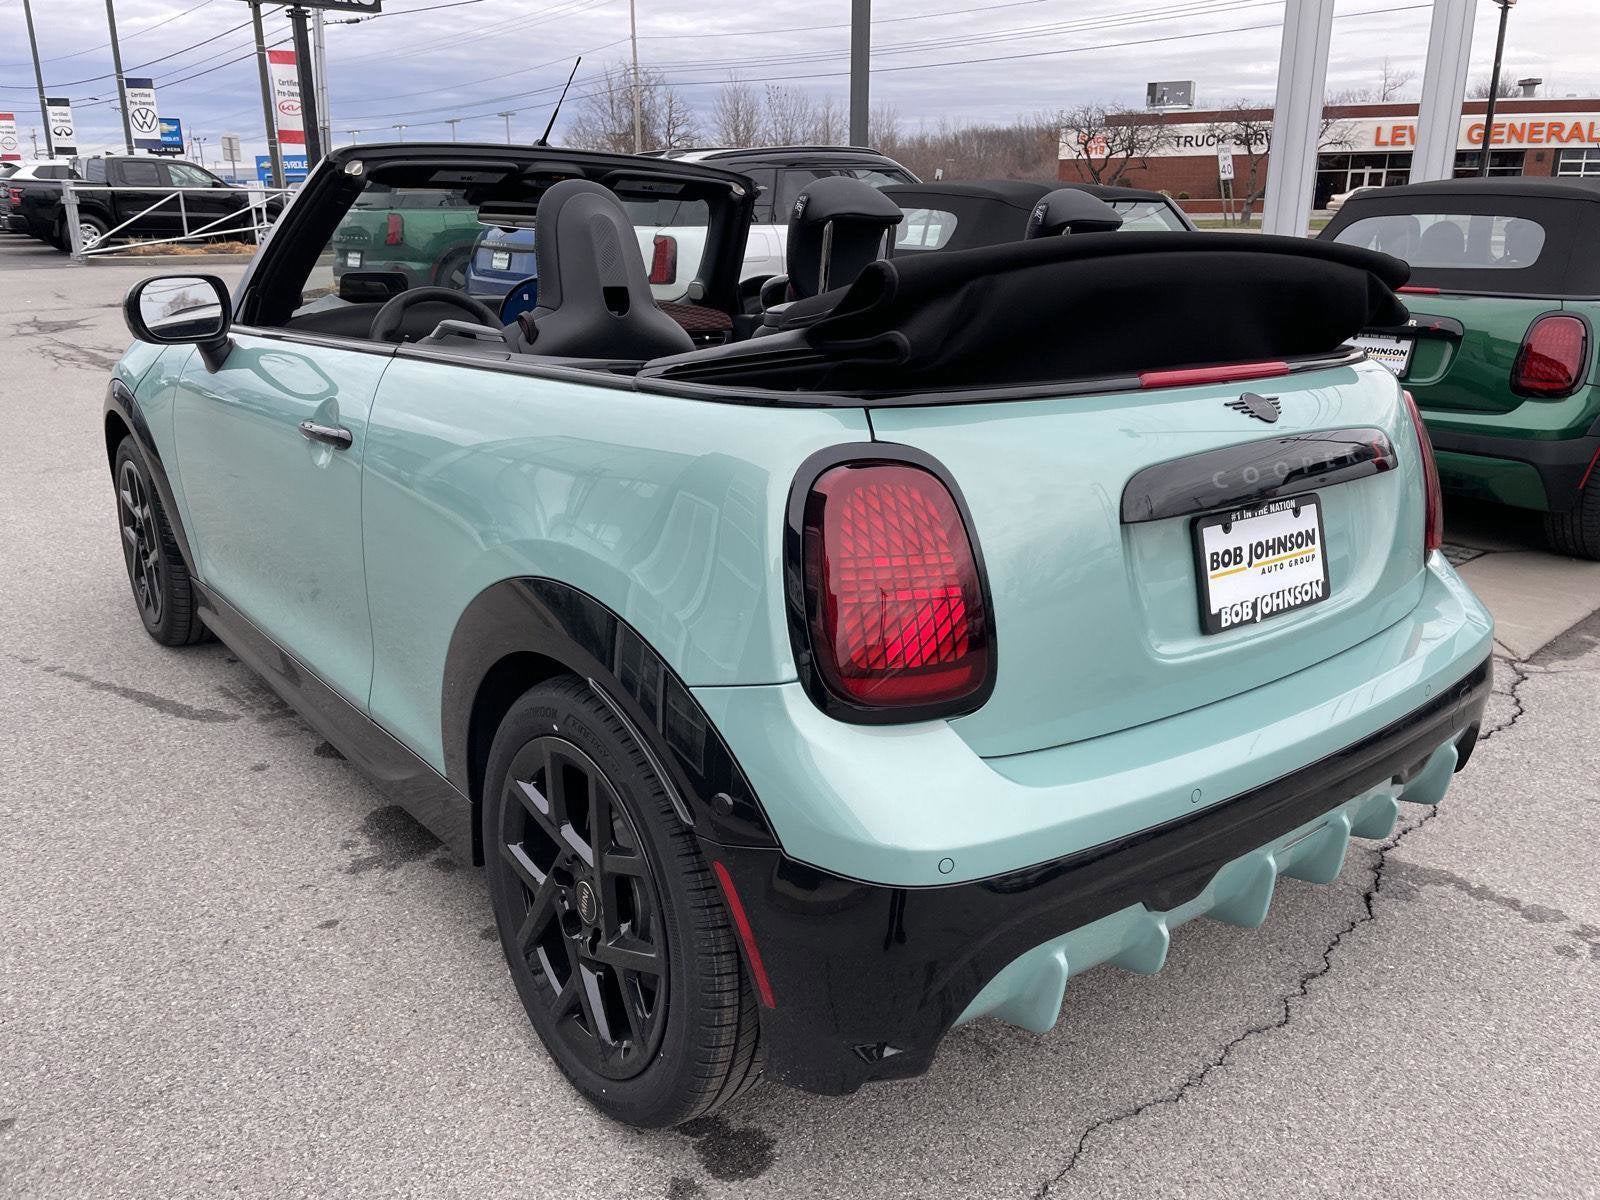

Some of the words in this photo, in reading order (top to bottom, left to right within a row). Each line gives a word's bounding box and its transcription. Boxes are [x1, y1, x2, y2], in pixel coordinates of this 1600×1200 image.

[278, 78, 299, 87] Certifie
[277, 89, 300, 97] Pre-Own
[1174, 133, 1226, 148] TRUCK
[1467, 121, 1600, 145] GENERAL
[283, 160, 308, 169] EVROLE
[1221, 163, 1232, 175] 40
[1212, 448, 1359, 488] COOPER
[1269, 499, 1296, 514] NATION
[1209, 546, 1244, 571] BOB
[1247, 528, 1316, 568] JOHNSON
[1261, 563, 1284, 575] AUTO
[1288, 554, 1316, 568] GROUP
[1220, 600, 1253, 628] BOB
[1256, 579, 1323, 622] JOHNSON
